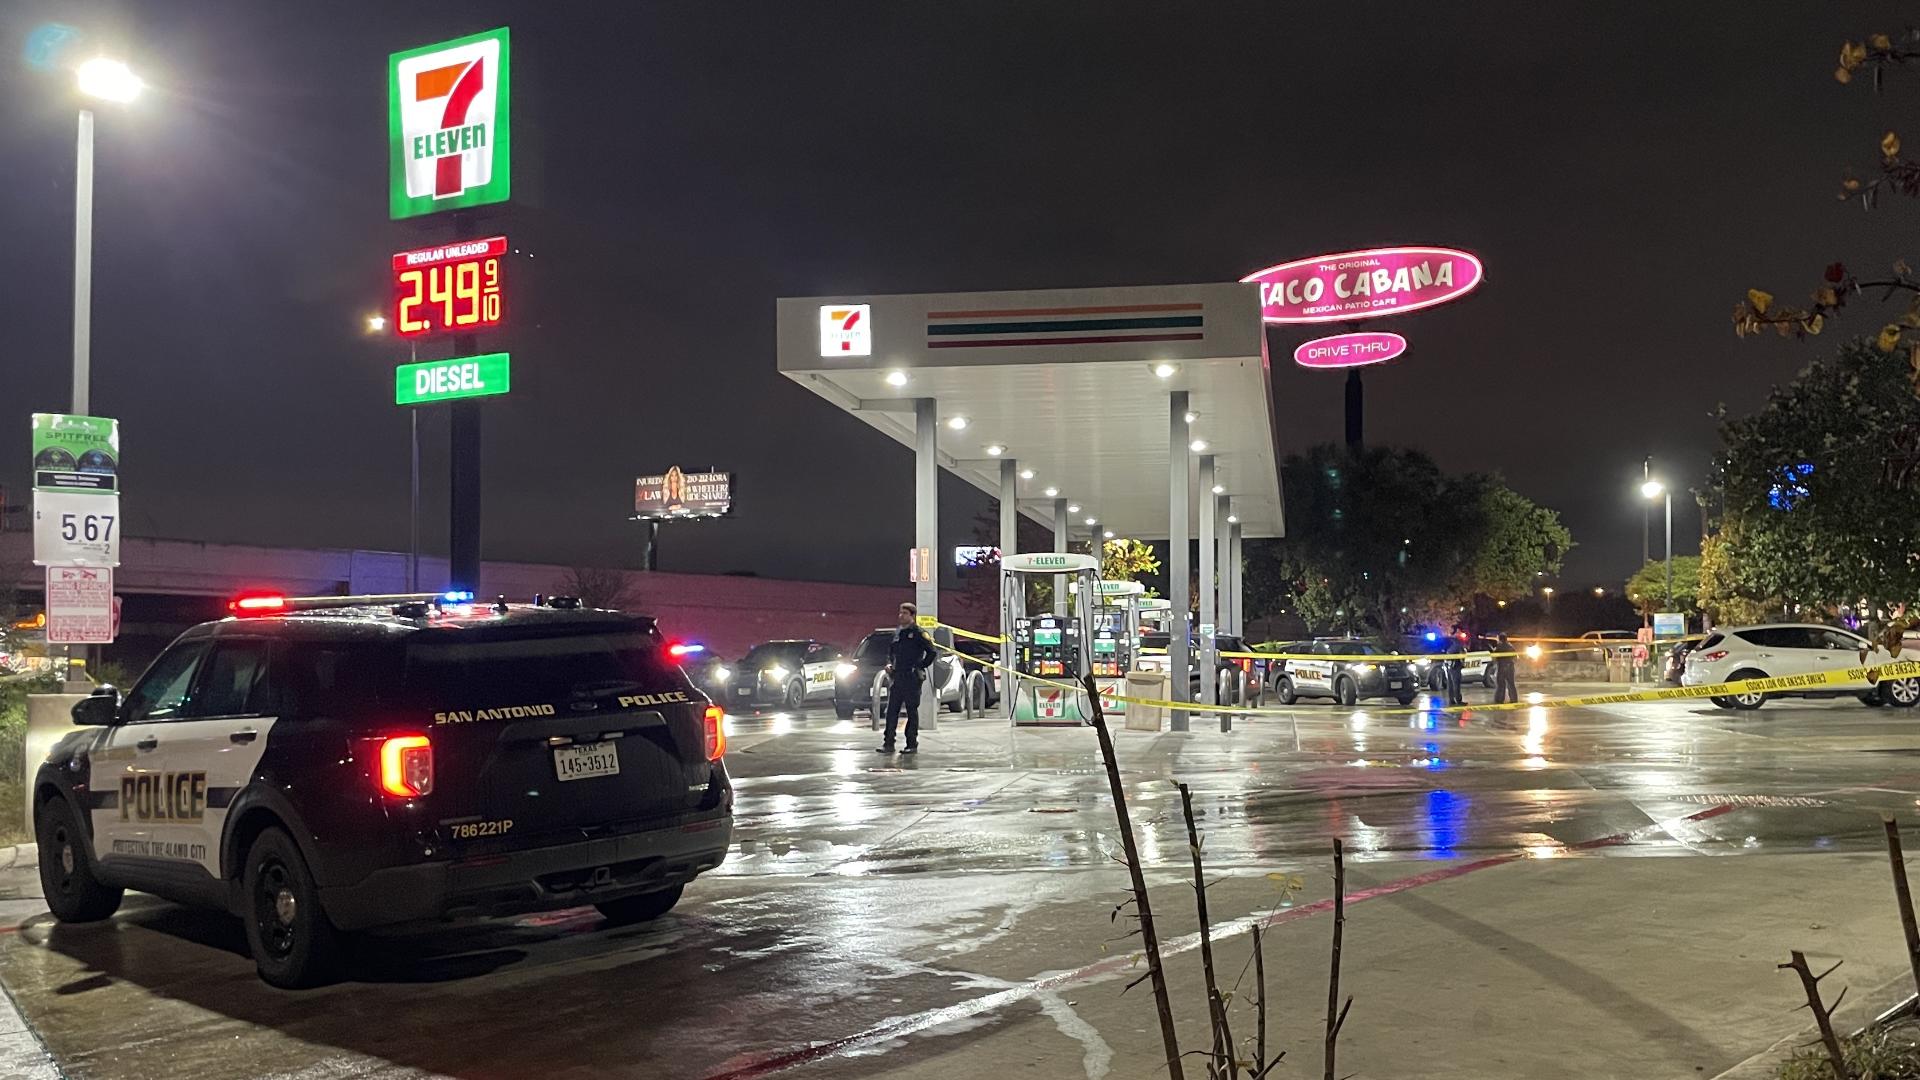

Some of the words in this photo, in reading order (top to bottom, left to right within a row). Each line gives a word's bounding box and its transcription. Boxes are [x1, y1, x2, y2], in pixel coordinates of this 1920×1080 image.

[416, 55, 484, 197] 7
[414, 123, 486, 160] ELEVEN
[407, 249, 445, 265] REGULAR
[446, 242, 489, 259] UNLEADED
[1319, 263, 1337, 272] THE
[1338, 258, 1381, 270] ORIGINAL
[1333, 261, 1453, 299] CABANA
[400, 262, 479, 332] 2.49
[1302, 304, 1343, 315] MEXICAN
[1344, 301, 1371, 310] PATIO
[1308, 345, 1350, 359] DRIVE
[1352, 341, 1391, 354] THRU
[415, 362, 485, 395] DIESEL
[1027, 556, 1066, 565] 7-ELEVEN
[813, 671, 834, 683] POLICE
[1295, 669, 1323, 680] POLICE
[1883, 665, 1894, 676] DO
[1895, 662, 1917, 676] SCENE
[618, 691, 689, 708] POLICE
[434, 711, 473, 725] SAN
[476, 704, 556, 721] ANTONIO
[120, 771, 207, 823] POLICE
[451, 820, 514, 839] 786221P
[190, 843, 206, 860] CITY
